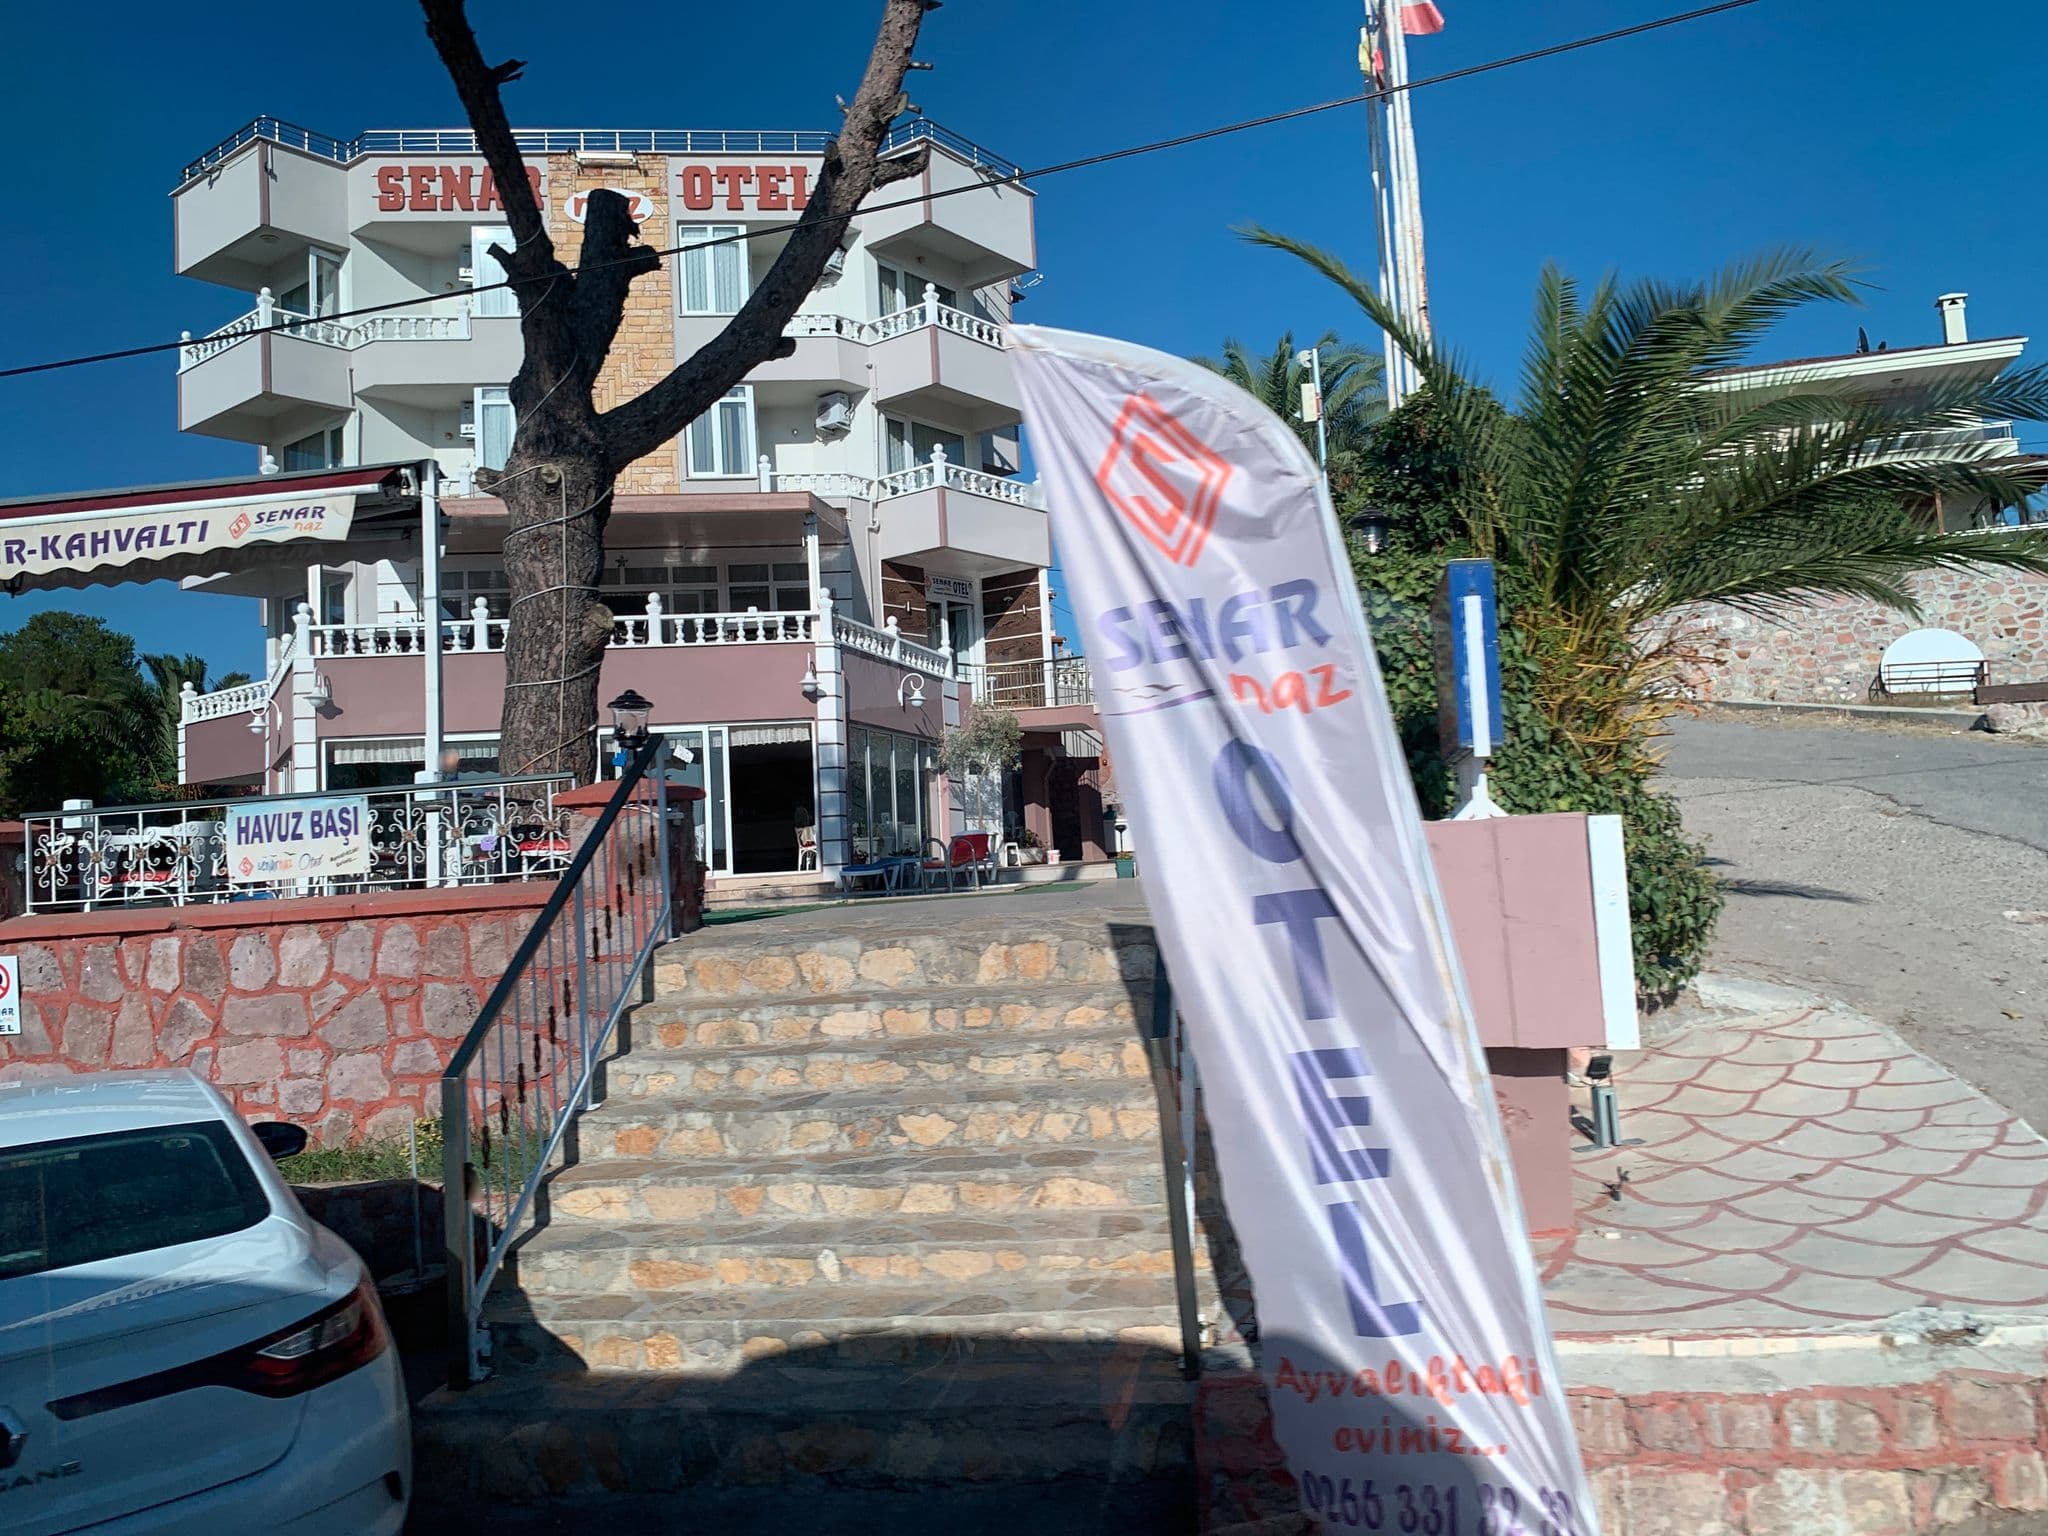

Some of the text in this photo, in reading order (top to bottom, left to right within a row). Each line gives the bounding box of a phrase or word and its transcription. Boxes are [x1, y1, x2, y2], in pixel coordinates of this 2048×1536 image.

[682, 165, 814, 211] OTEL
[254, 506, 326, 525] SENAR
[294, 521, 322, 532] naz
[952, 581, 969, 595] OTEL
[1099, 578, 1334, 673] SENAR
[1228, 663, 1353, 715] naz
[237, 806, 359, 846] HAVUZ BAŞI
[1213, 737, 1424, 1337] OTEL
[1302, 1470, 1384, 1530] 0266
[1395, 1484, 1460, 1536] 331
